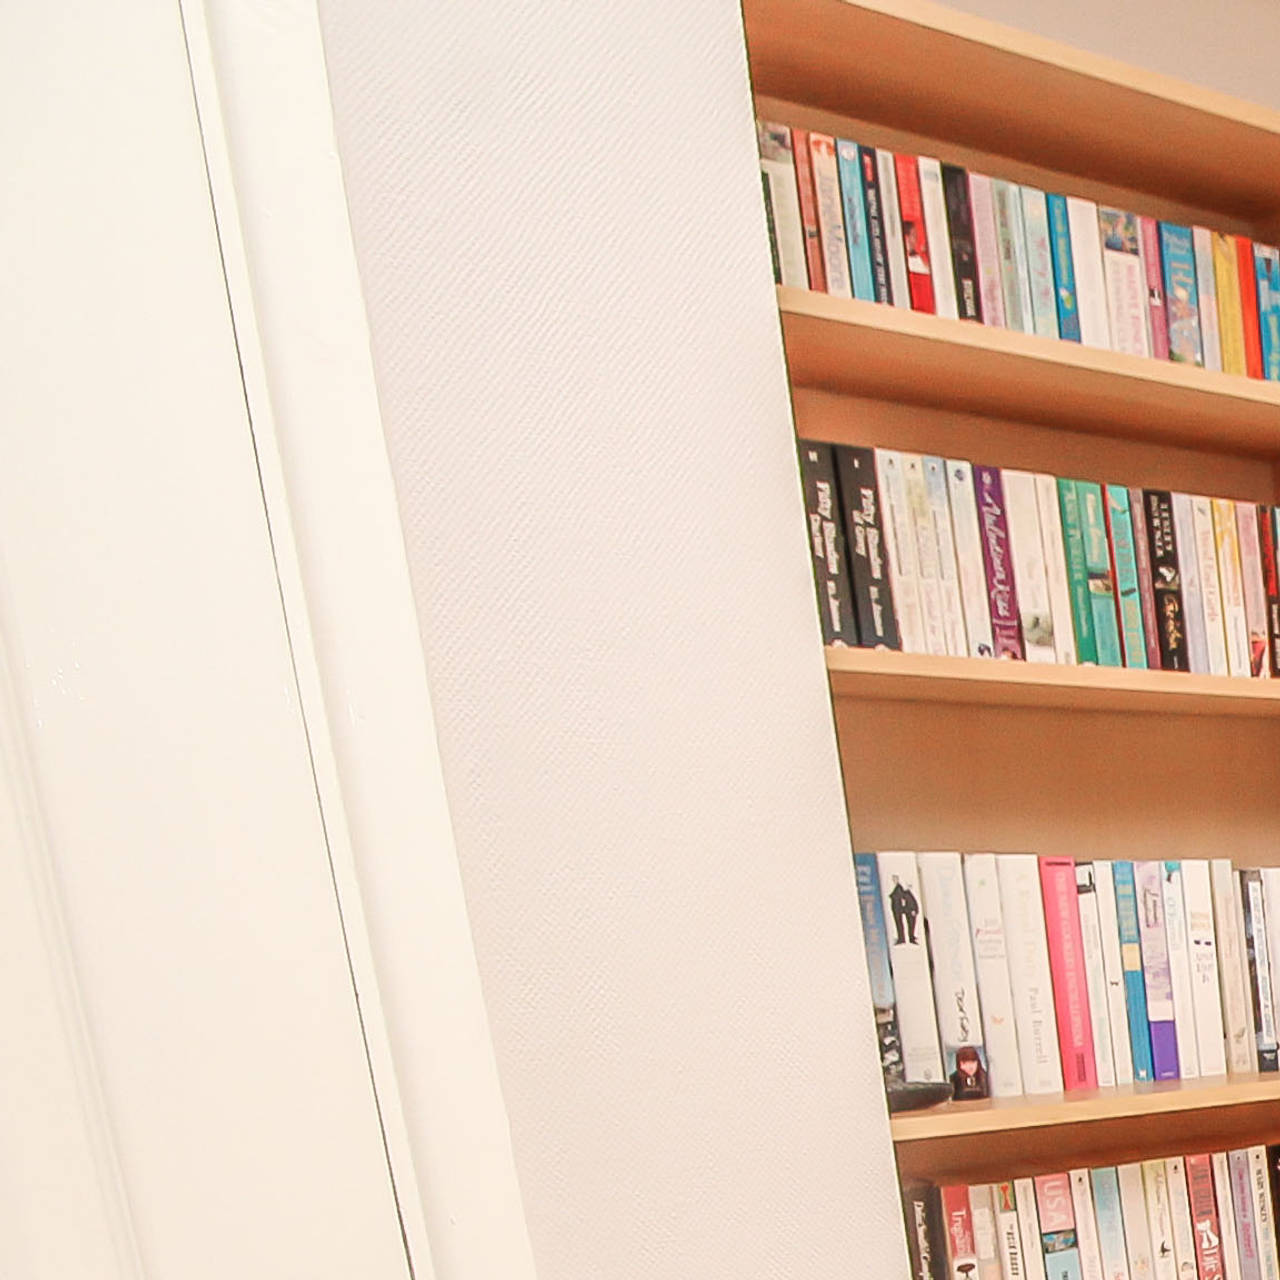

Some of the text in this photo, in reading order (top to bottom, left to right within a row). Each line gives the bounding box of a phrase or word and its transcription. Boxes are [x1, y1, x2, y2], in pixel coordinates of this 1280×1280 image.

[1027, 987, 1048, 1065] Paul Burrell
[1042, 1179, 1066, 1227] USA
